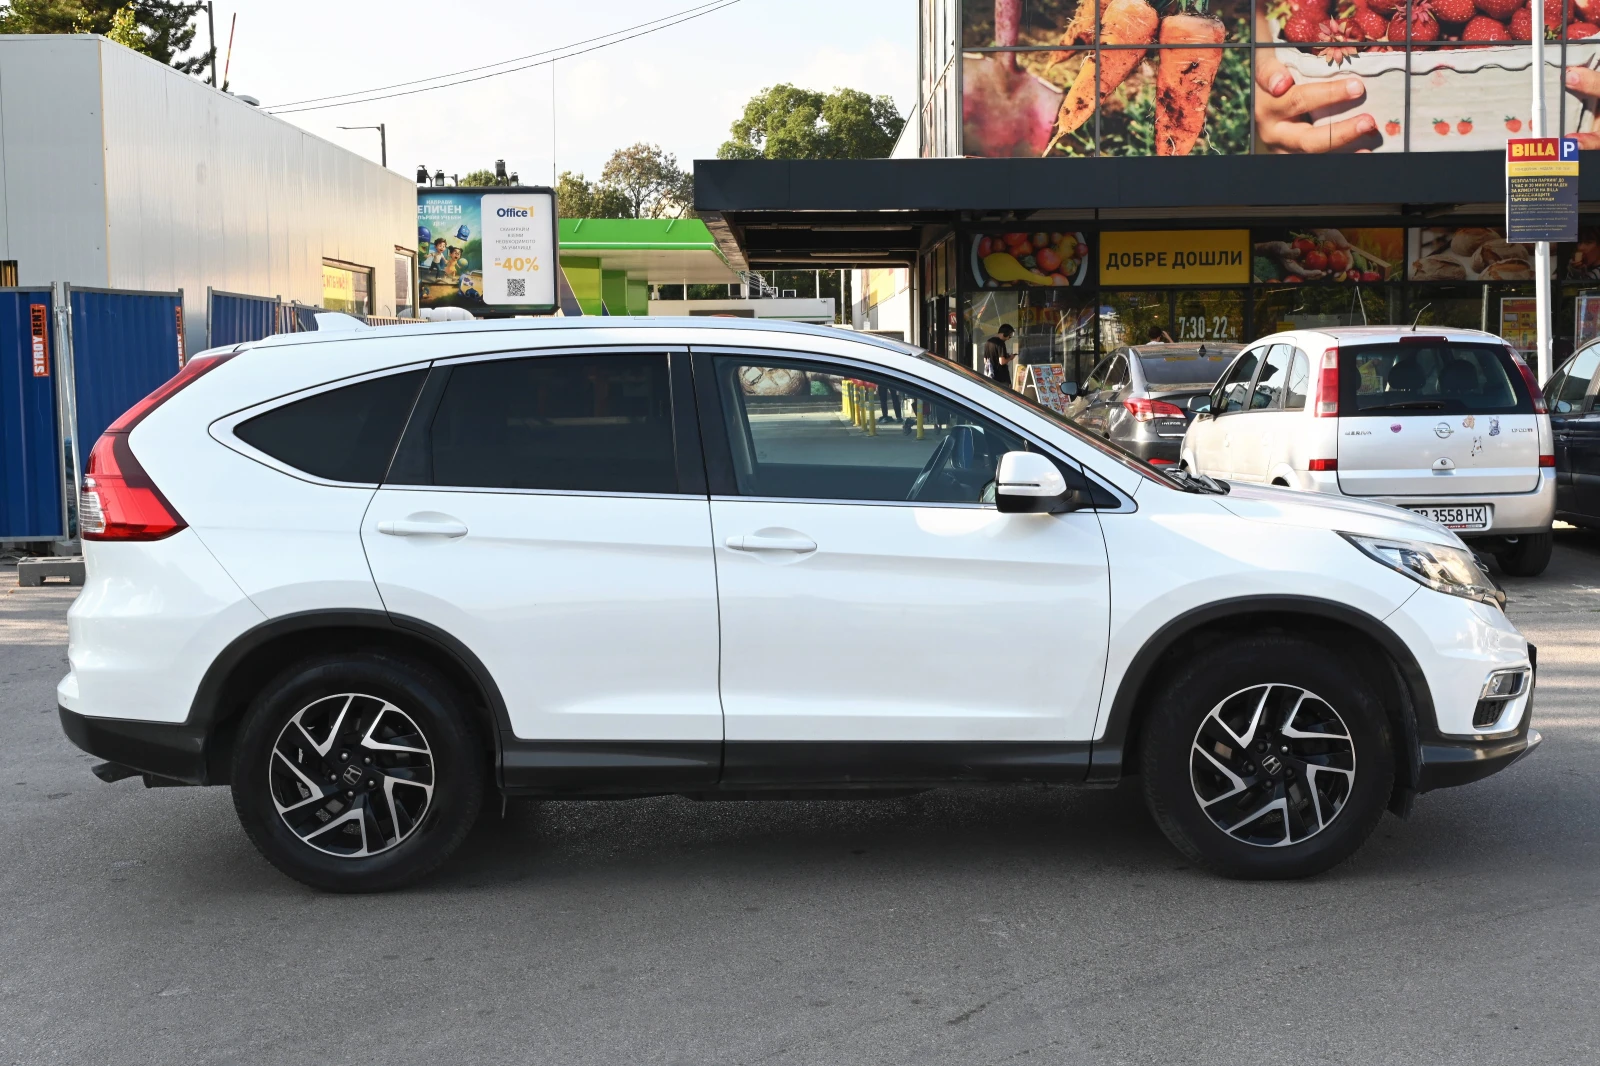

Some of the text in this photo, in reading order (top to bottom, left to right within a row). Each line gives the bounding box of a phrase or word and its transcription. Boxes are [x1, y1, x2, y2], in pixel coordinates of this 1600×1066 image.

[1512, 141, 1575, 158] BILLA P
[417, 205, 462, 214] ЕПИЧЕН
[495, 257, 539, 272] -40%
[1106, 250, 1242, 270] ДОБРЕ ДОШЛИ
[1432, 508, 1463, 522] 3558
[1466, 508, 1482, 522] HX
